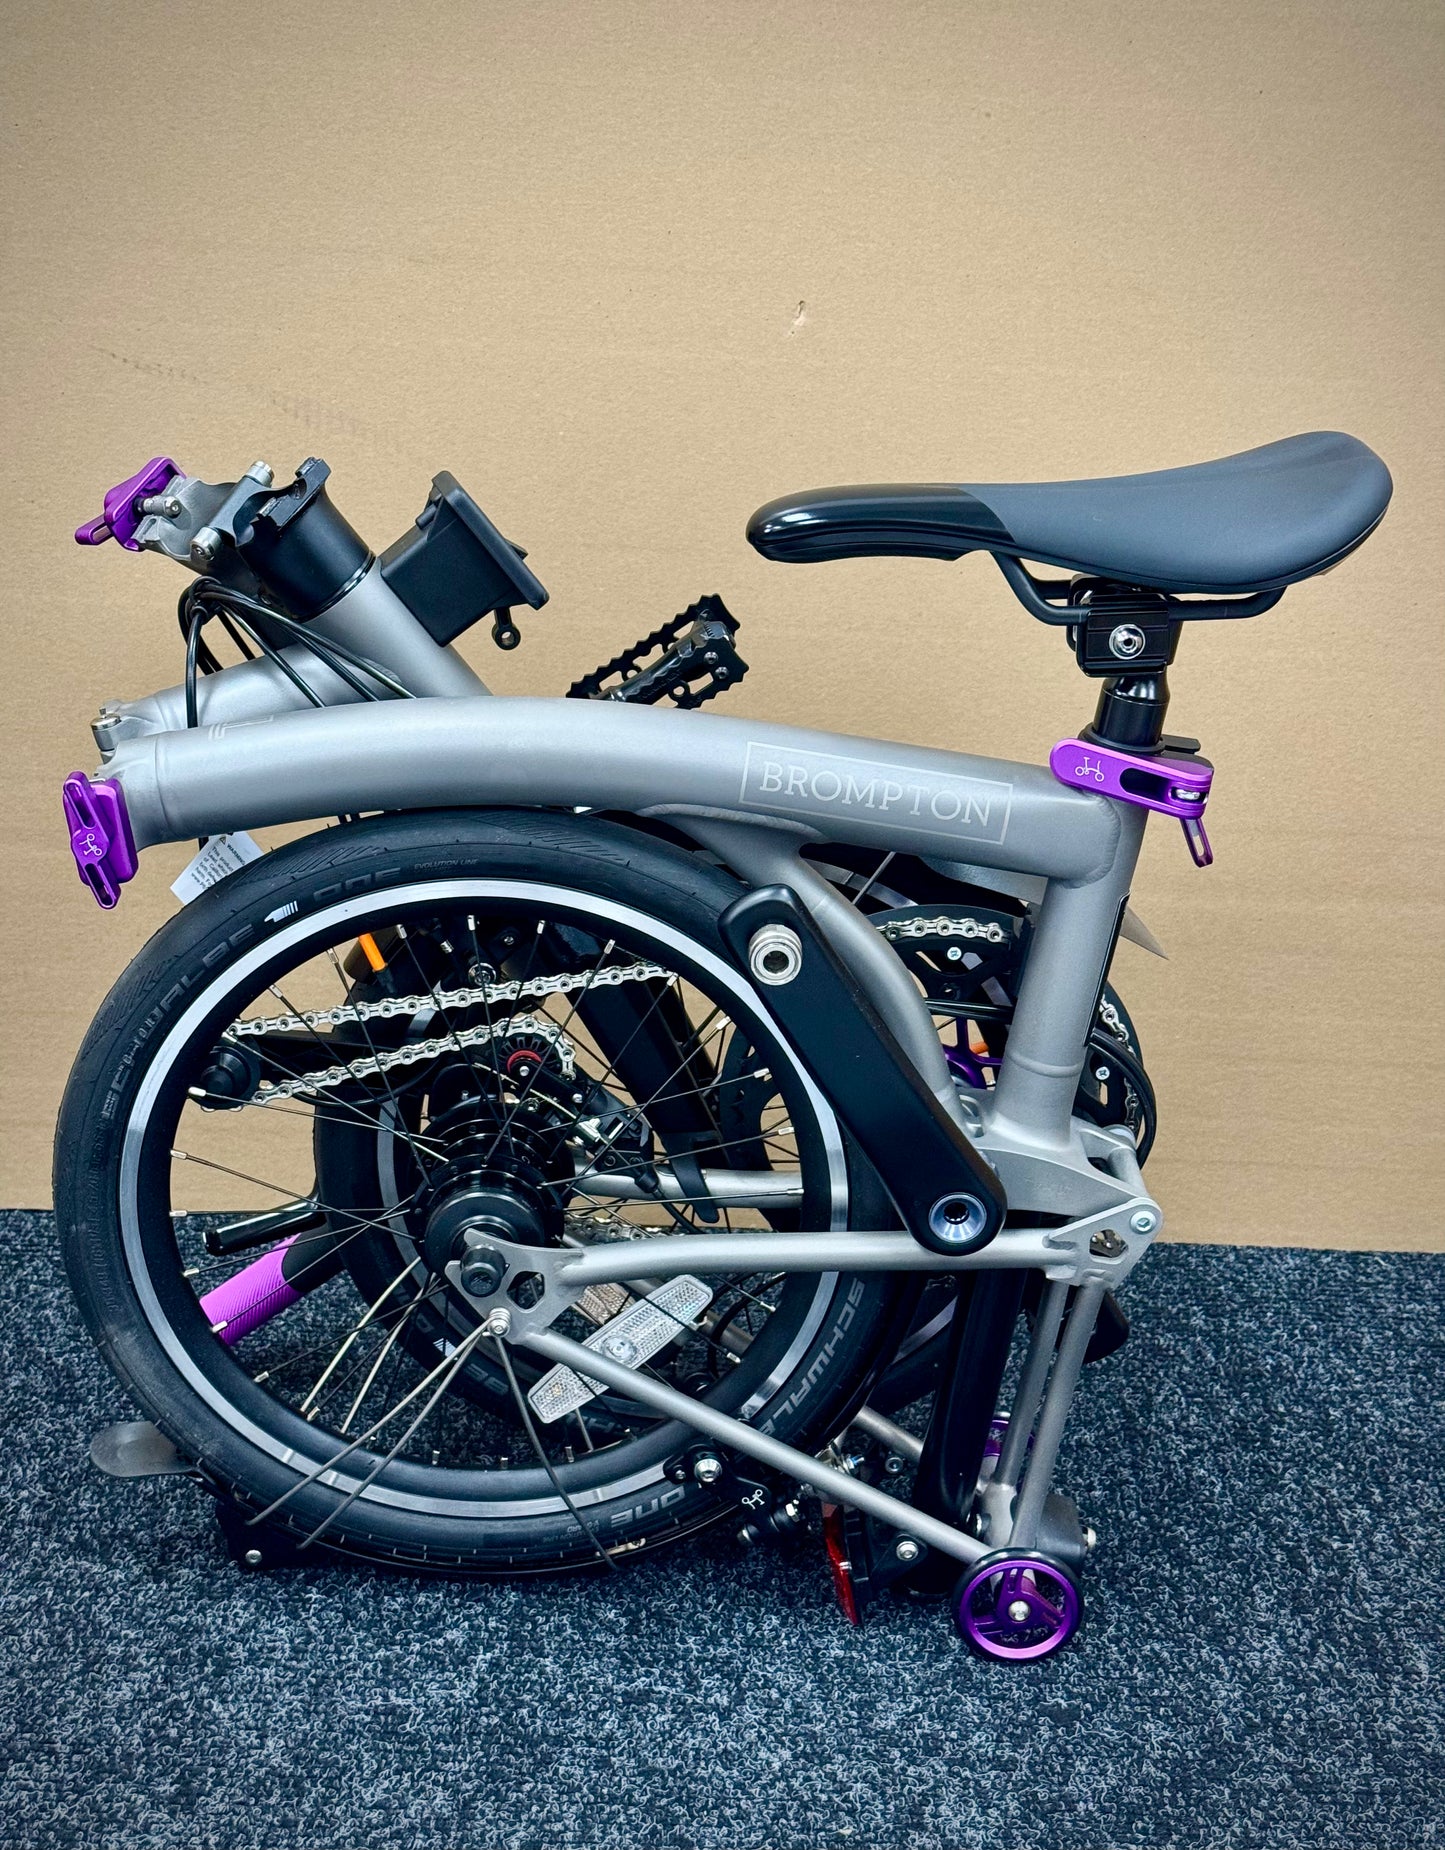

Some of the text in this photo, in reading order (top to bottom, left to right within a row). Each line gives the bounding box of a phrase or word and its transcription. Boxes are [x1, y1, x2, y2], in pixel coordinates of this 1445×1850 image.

[760, 761, 991, 827] BROMPTON
[227, 844, 245, 865] WARNING
[414, 858, 479, 870] EVOLUTION LINE
[313, 867, 401, 901] ONE
[758, 1277, 866, 1436] SCHWALB
[611, 1485, 686, 1528] ONE
